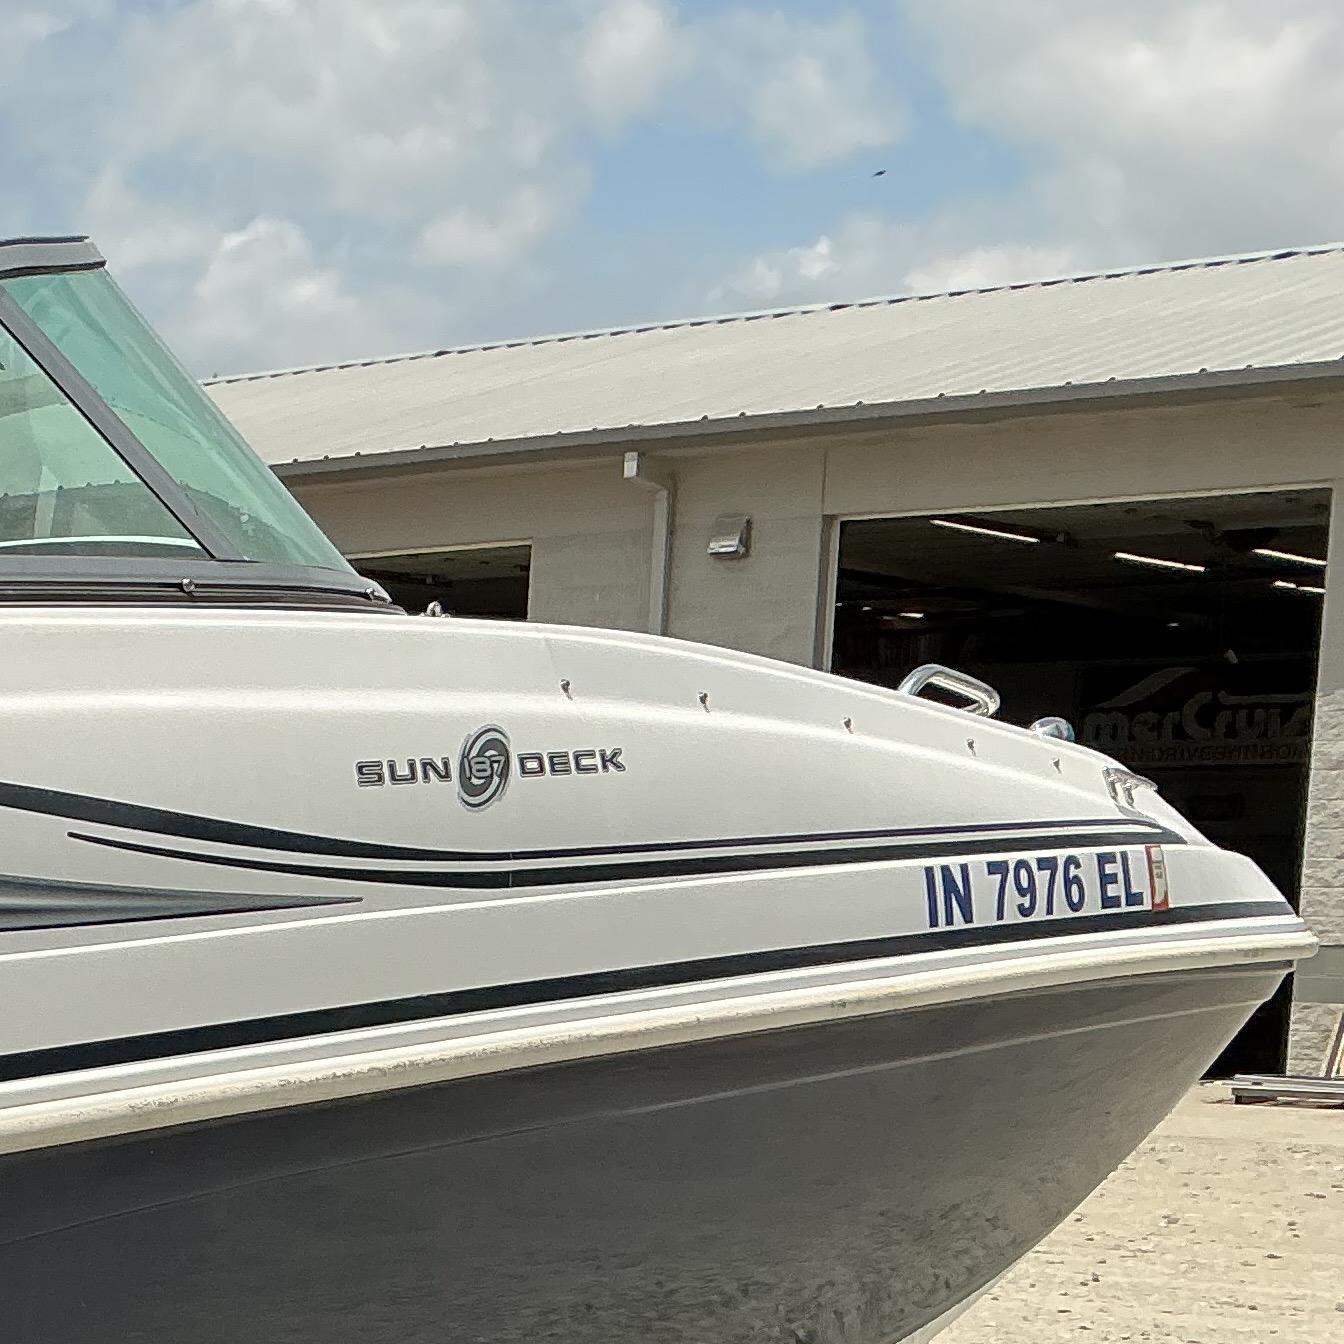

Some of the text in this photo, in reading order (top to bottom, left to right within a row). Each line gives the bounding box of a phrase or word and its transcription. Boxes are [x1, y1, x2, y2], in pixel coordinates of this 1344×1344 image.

[355, 748, 626, 788] SUN 187 DECK
[924, 850, 1144, 928] IN 7976 EL
